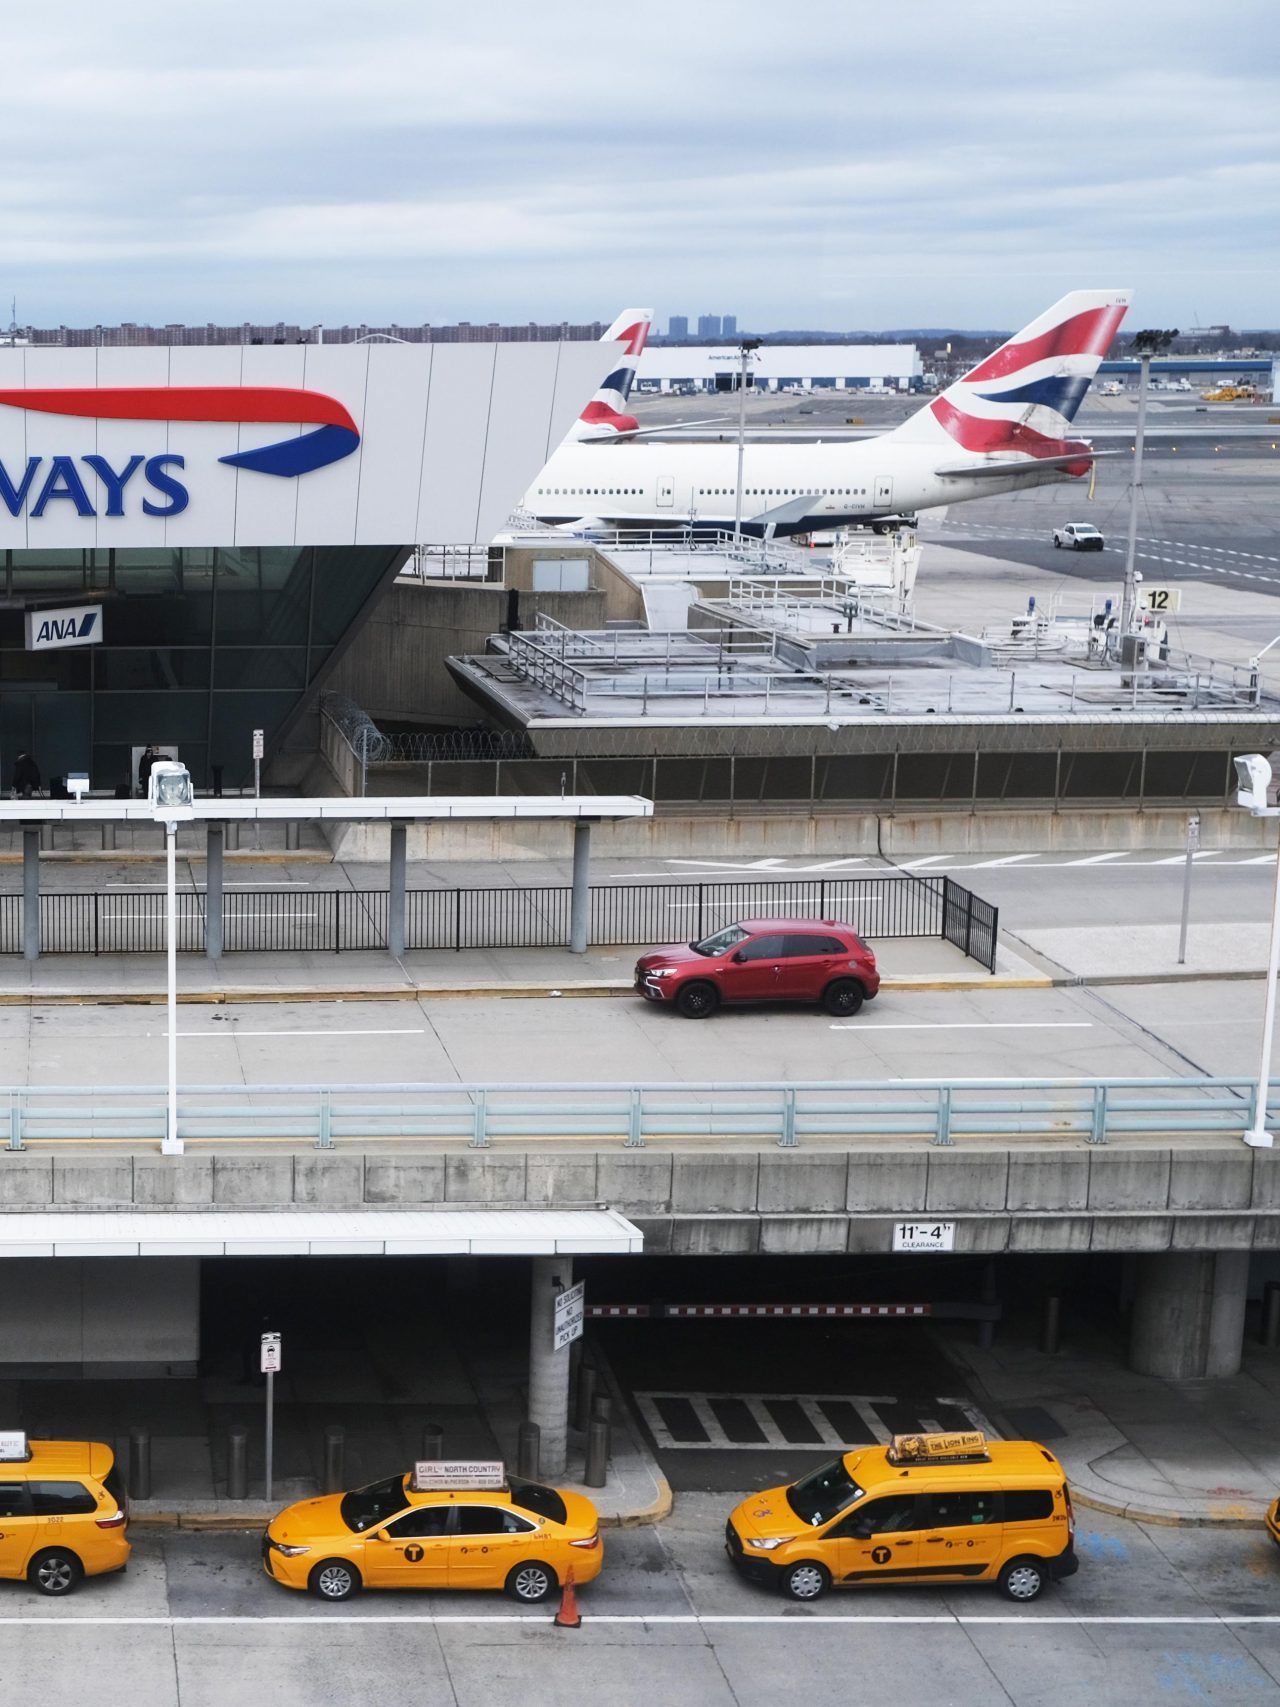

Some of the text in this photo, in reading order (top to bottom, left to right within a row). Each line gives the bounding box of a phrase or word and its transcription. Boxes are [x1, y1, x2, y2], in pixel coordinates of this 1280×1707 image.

[1148, 590, 1169, 609] 12
[36, 617, 77, 642] ANA
[557, 1297, 563, 1307] NO
[566, 1306, 573, 1316] NO
[559, 1325, 578, 1344] PICK UP
[931, 1442, 943, 1451] THE
[444, 1465, 467, 1473] NORTH
[468, 1465, 500, 1473] COUNTRY
